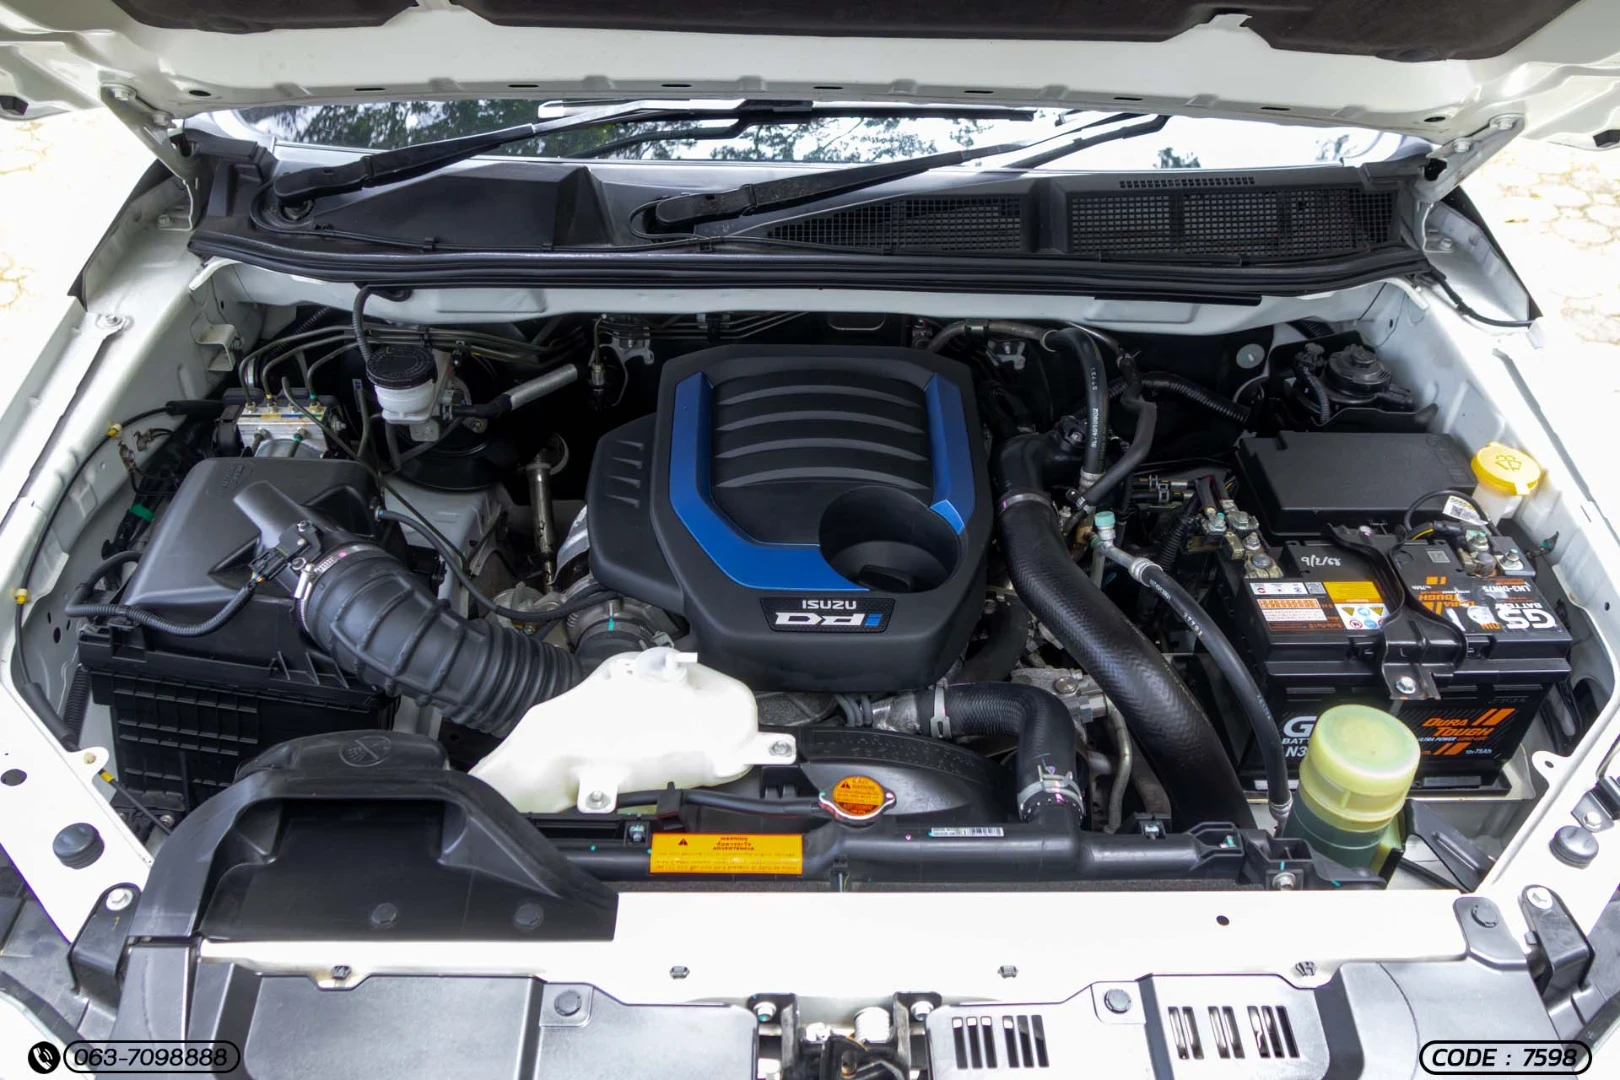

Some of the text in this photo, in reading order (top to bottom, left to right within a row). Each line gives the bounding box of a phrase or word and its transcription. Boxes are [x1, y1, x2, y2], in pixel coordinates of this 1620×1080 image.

[802, 600, 856, 609] ISUZU
[1497, 608, 1556, 629] GS
[1422, 717, 1468, 727] DURA
[1433, 727, 1495, 737] TOUGH
